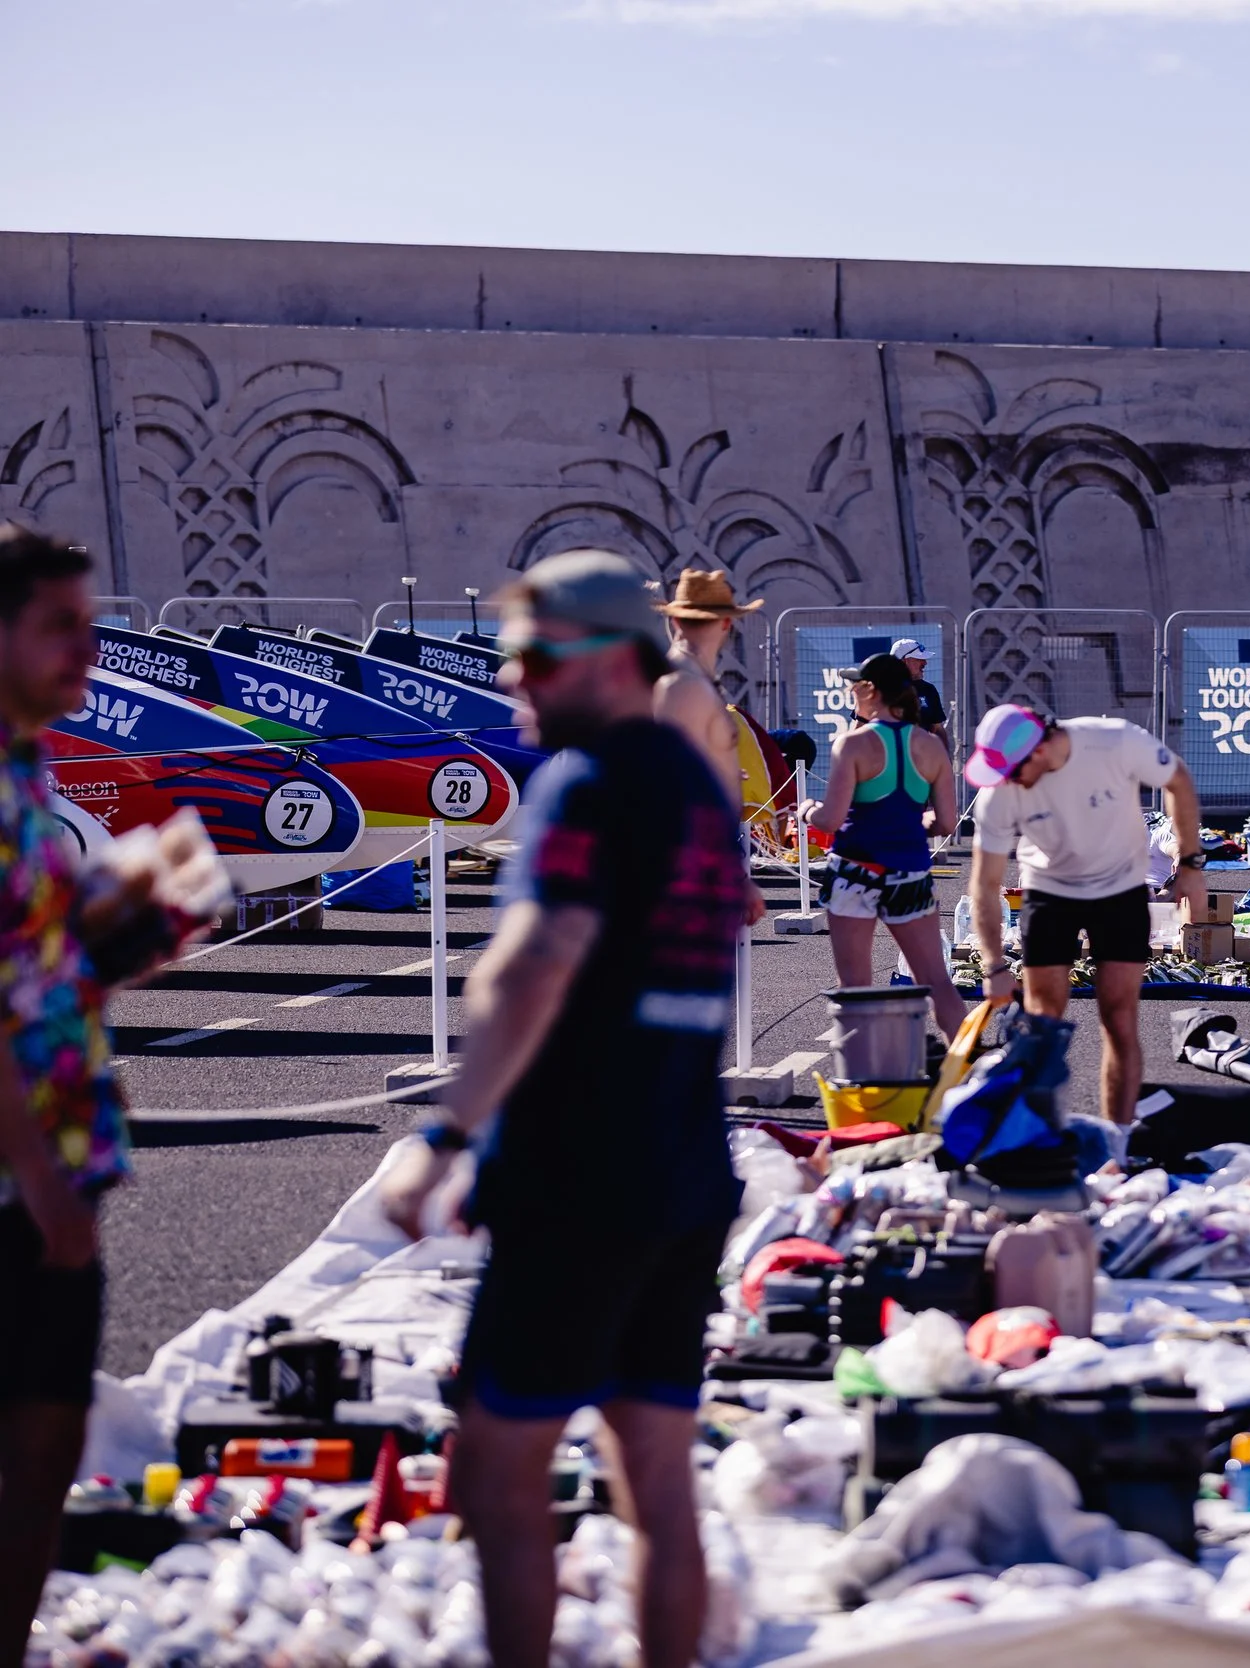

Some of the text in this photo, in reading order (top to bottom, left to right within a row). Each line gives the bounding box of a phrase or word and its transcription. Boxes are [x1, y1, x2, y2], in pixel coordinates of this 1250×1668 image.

[99, 639, 188, 671] WORLD'S
[255, 651, 345, 682] TOUGHEST
[258, 640, 334, 667] WORLD'S
[421, 645, 487, 669] WORLD'S
[96, 651, 200, 690] TOUGHEST
[418, 656, 496, 684] TOUGHEST
[235, 673, 329, 727] ROW
[378, 670, 458, 719] ROW
[63, 688, 144, 738] OW
[445, 780, 471, 804] 28
[281, 802, 314, 831] 27
